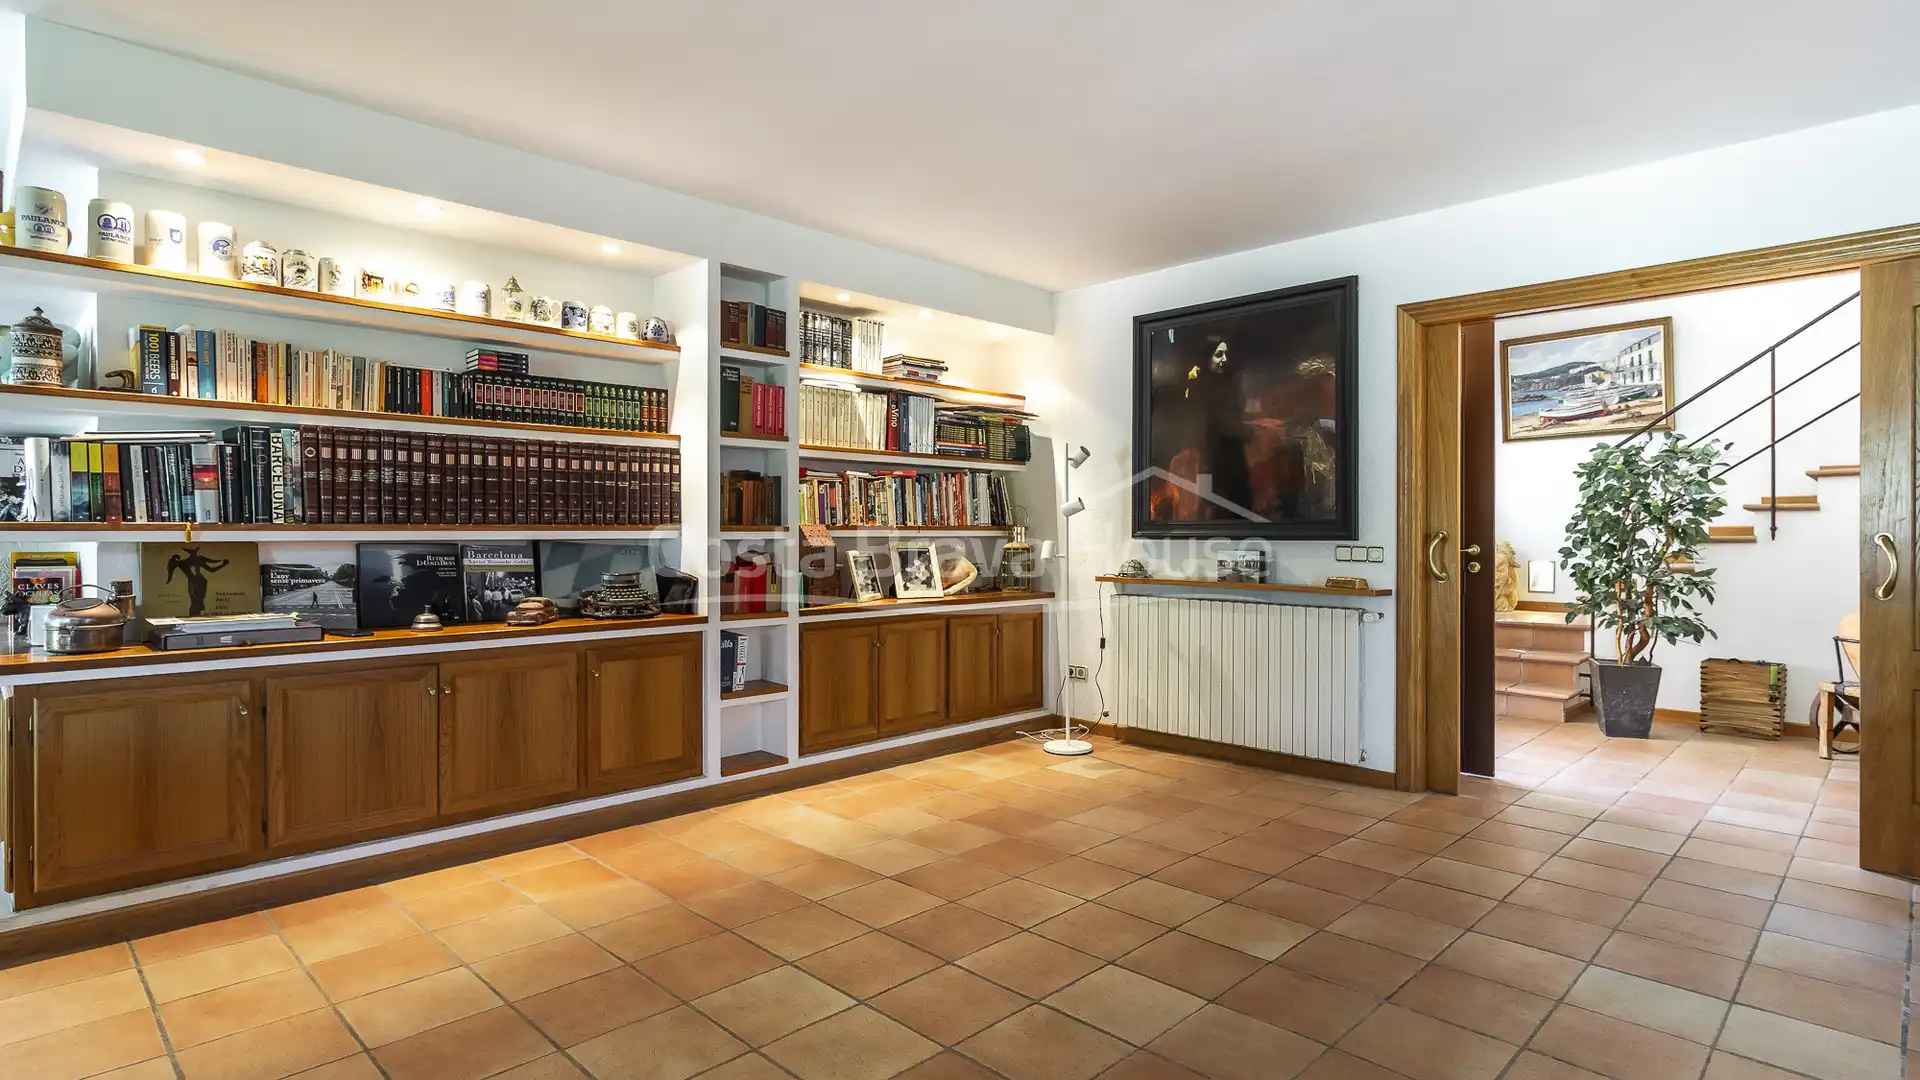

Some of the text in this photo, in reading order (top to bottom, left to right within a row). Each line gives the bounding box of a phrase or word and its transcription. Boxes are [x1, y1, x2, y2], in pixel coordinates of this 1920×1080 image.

[149, 333, 160, 380] 1001 BEERS
[271, 436, 283, 520] BARCELONA
[467, 550, 523, 559] Barcelona
[290, 578, 326, 586] primavera
